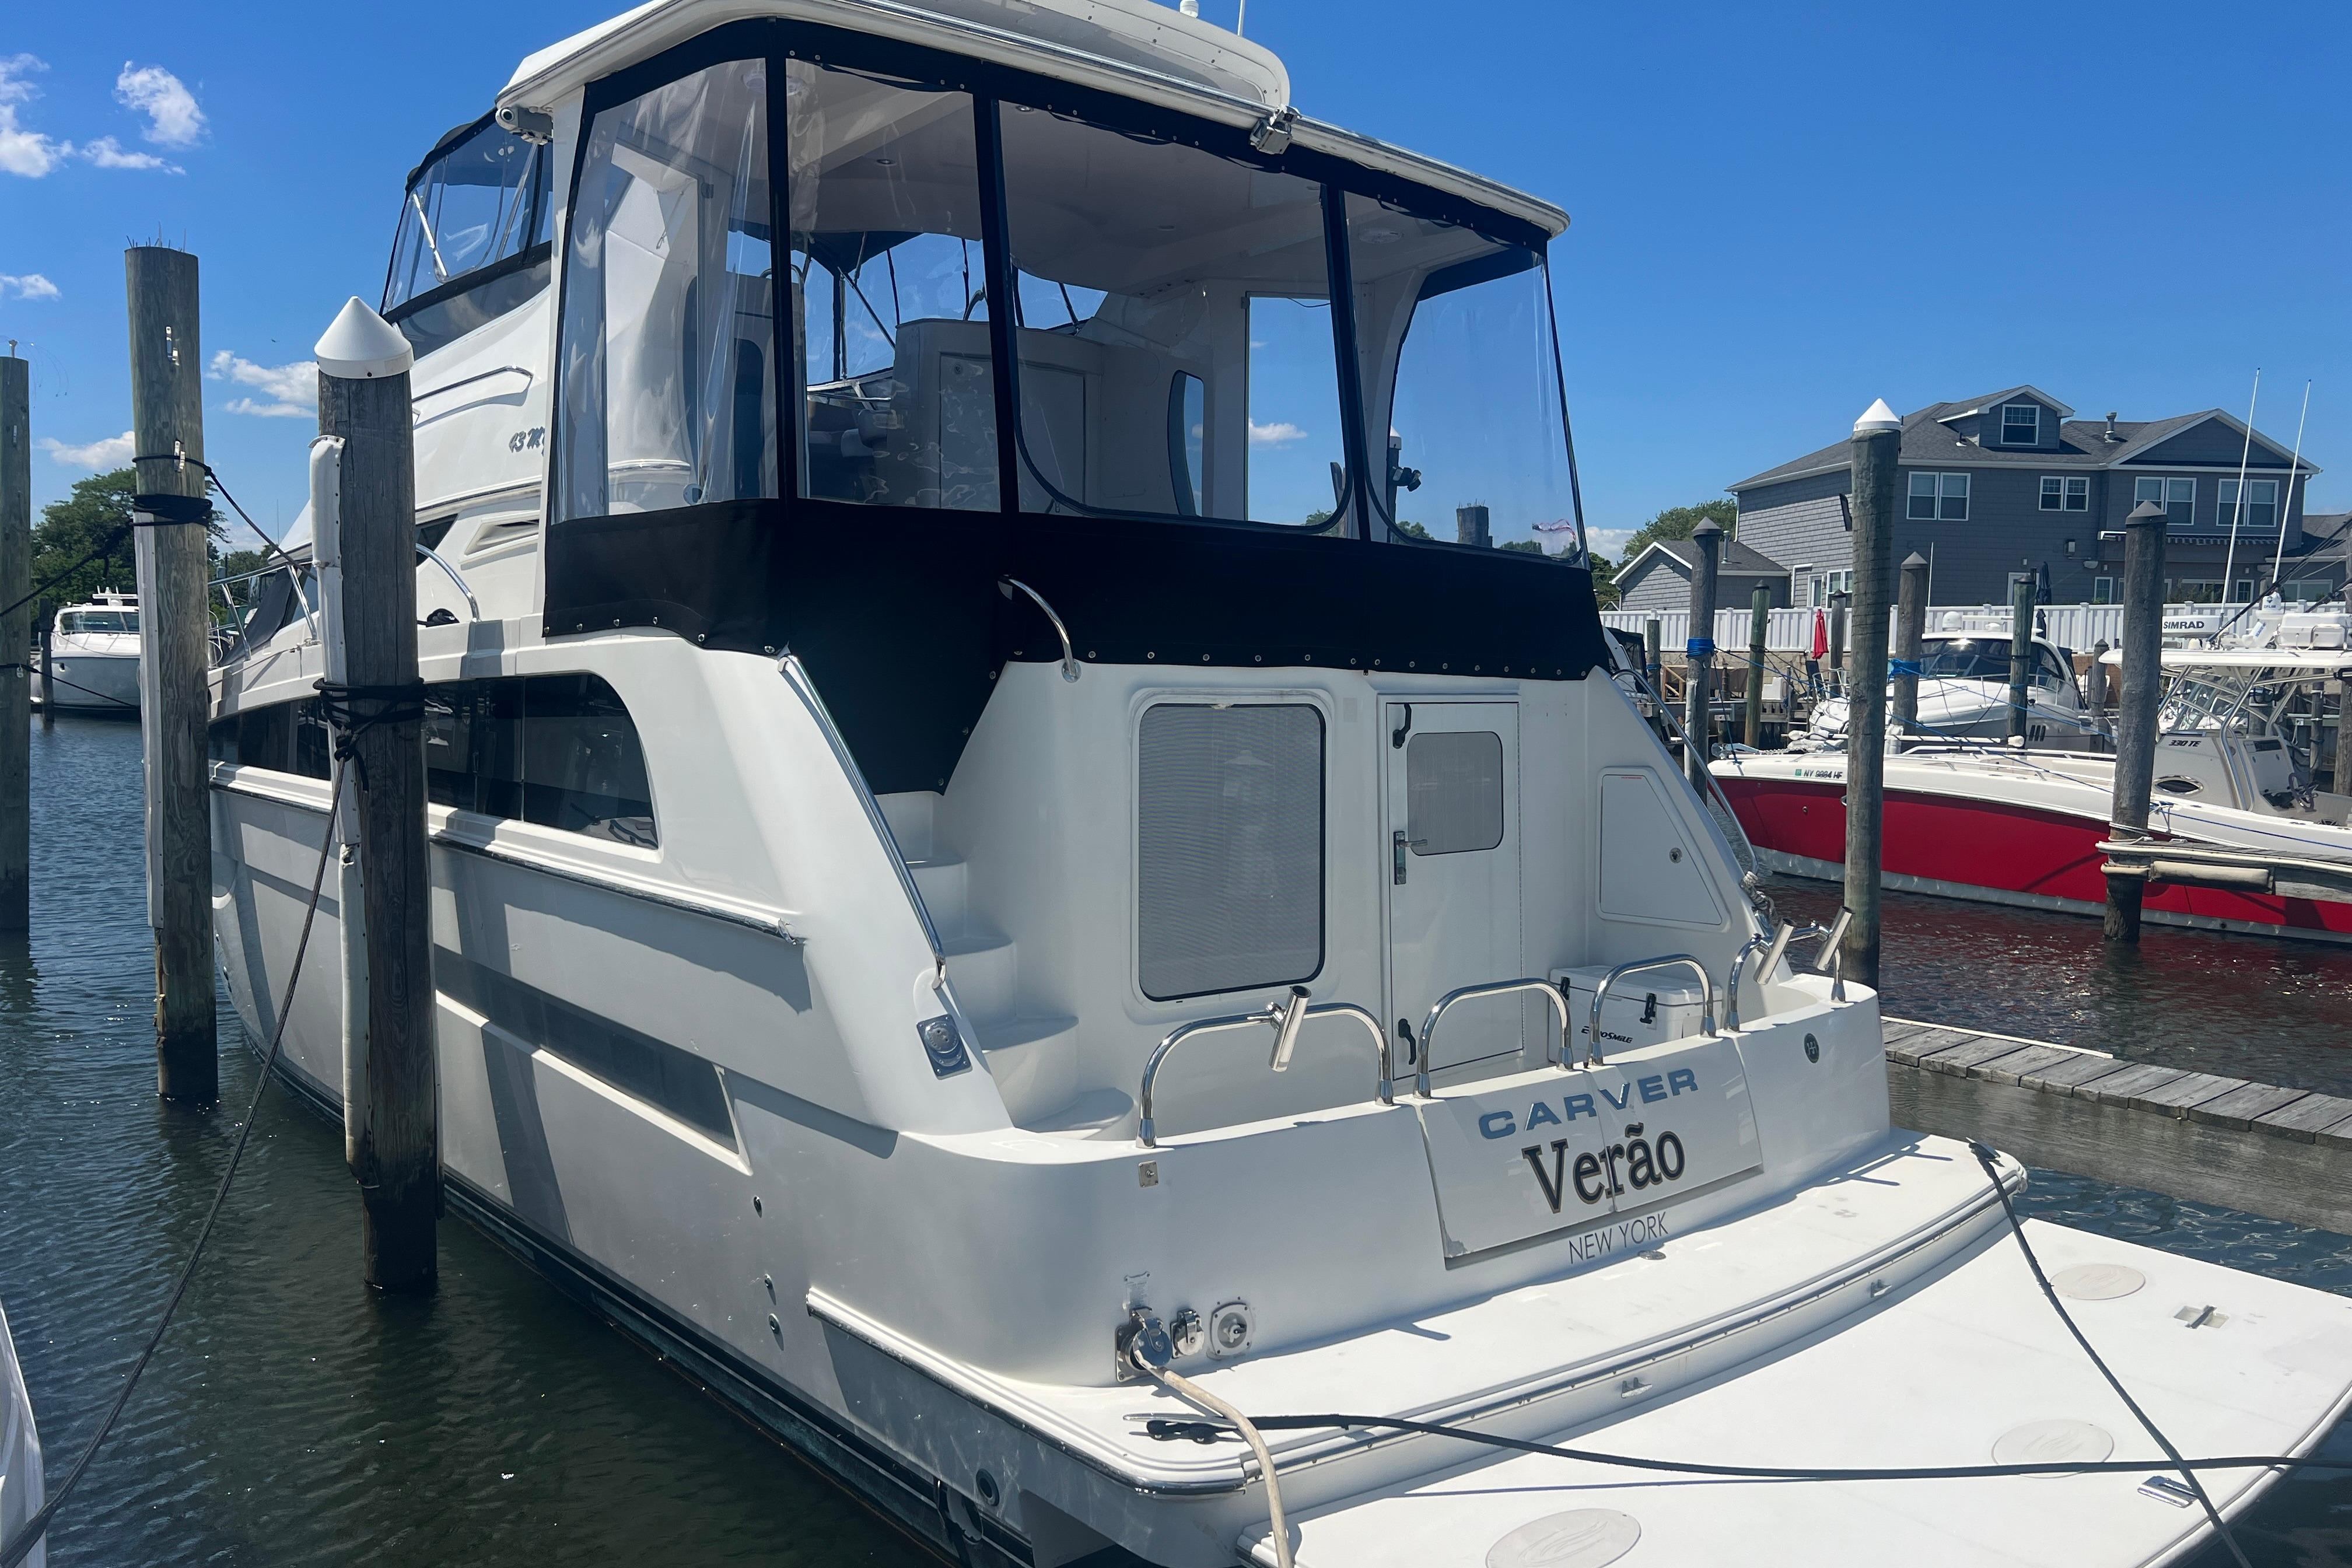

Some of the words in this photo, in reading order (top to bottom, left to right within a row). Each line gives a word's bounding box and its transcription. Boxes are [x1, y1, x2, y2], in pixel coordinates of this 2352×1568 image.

[2163, 621, 2204, 629] SIMRAD
[1479, 1068, 1698, 1139] CARVER
[1521, 1122, 1685, 1213] Verão
[1569, 1227, 1612, 1264] NEW
[1619, 1212, 1668, 1248] YORK
